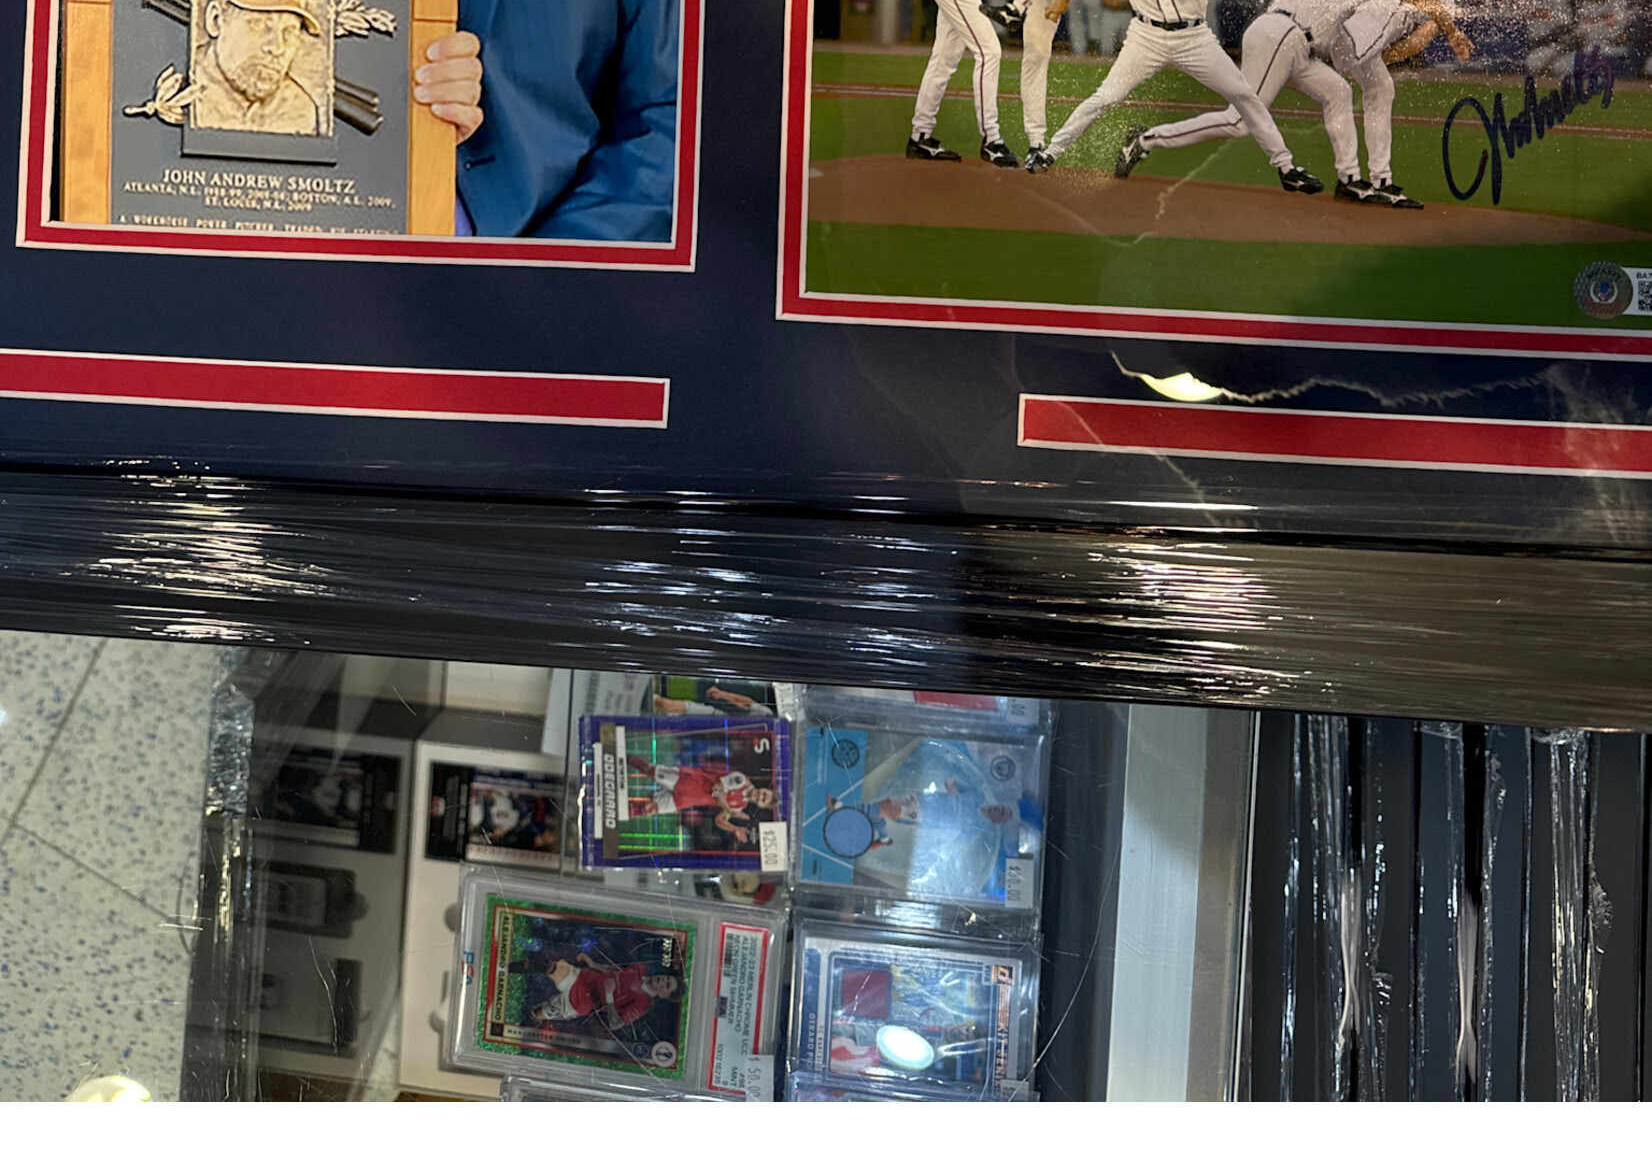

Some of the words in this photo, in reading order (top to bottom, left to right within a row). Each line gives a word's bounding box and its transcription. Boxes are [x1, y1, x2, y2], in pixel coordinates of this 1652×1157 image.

[162, 169, 206, 185] JOHN
[210, 173, 283, 189] ANDREW
[287, 176, 356, 194] SMOLTZ
[604, 754, 616, 829] ODEGAARD
[763, 830, 779, 865] $25.00
[498, 915, 511, 969] ALEJANDRO
[731, 935, 740, 958] NEON
[729, 960, 739, 986] GREEN
[737, 936, 749, 985] ALEJANDRO
[494, 970, 507, 1021] GARNACHO
[745, 971, 755, 1001] MERLIN
[727, 987, 737, 1024] SHIMMER
[734, 986, 745, 1032] GARNACHO
[741, 1002, 752, 1037] CHROME
[730, 1066, 738, 1088] MINT
